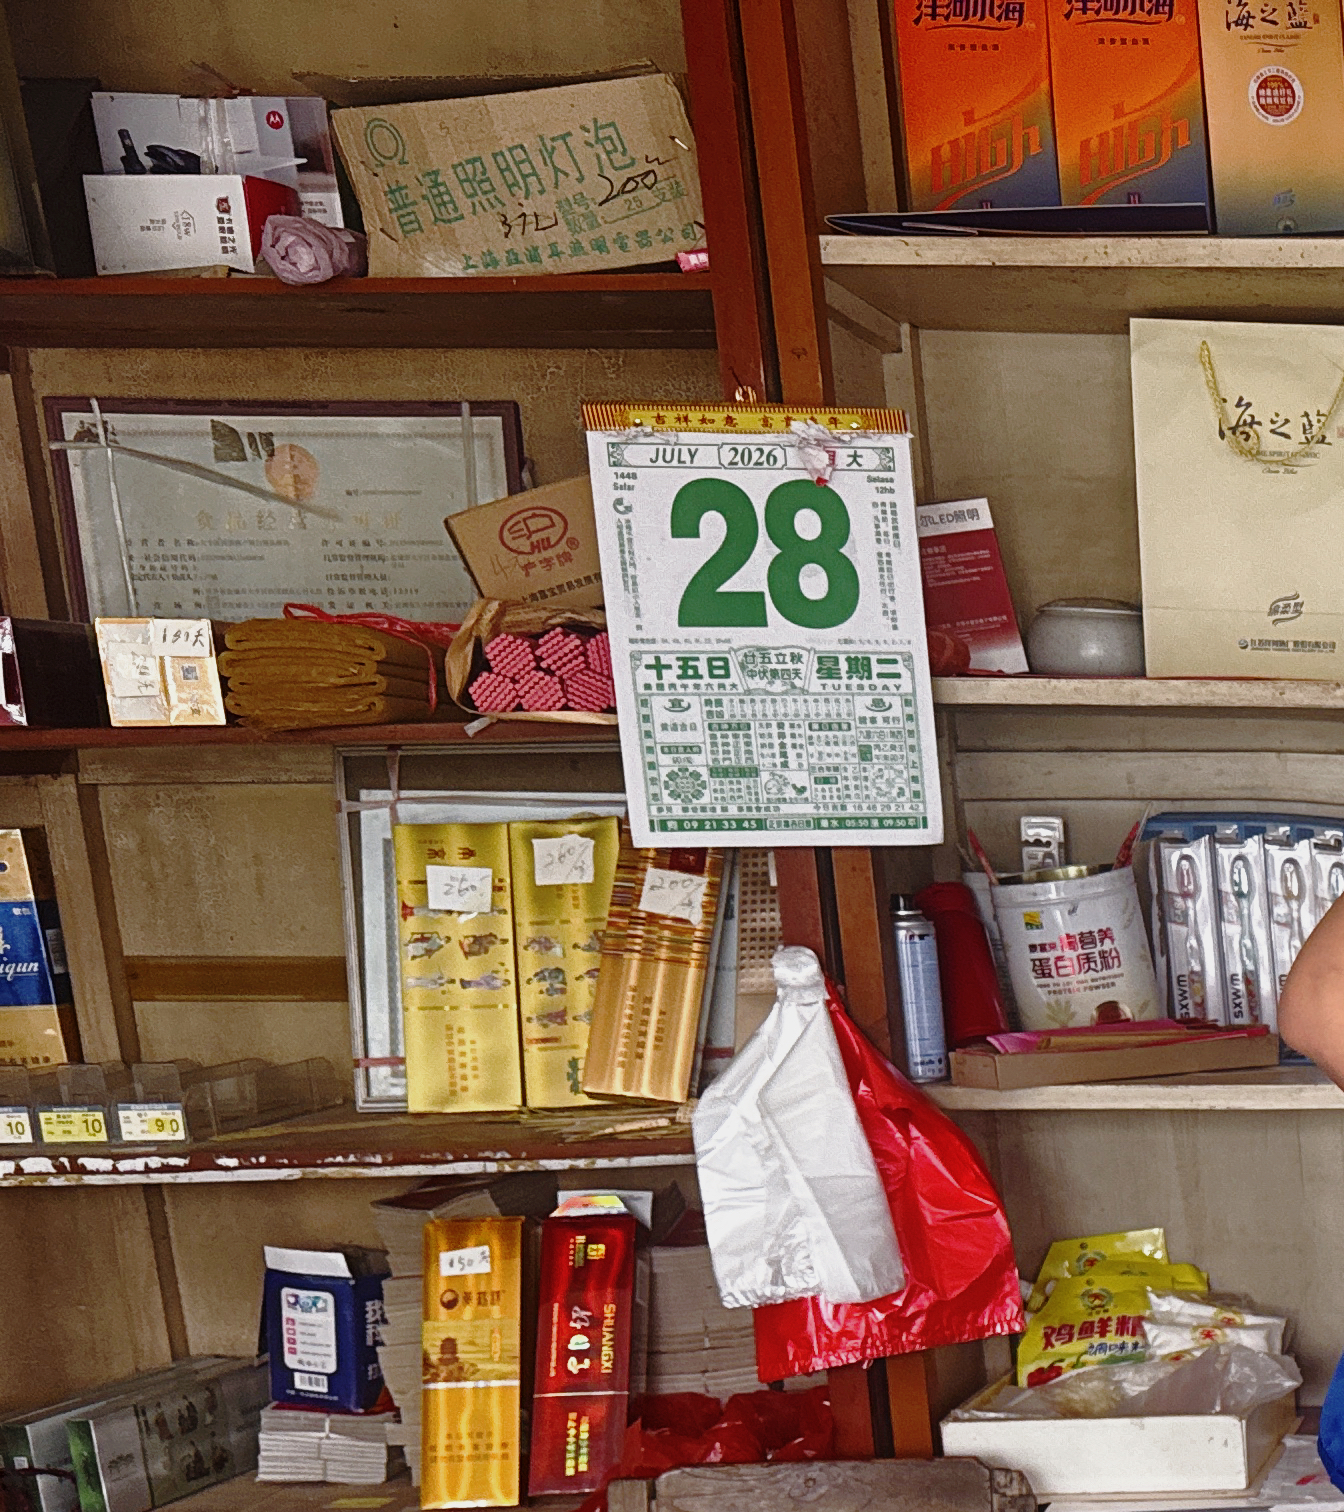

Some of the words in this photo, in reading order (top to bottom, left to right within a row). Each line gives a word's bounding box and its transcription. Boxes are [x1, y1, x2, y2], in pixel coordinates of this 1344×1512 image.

[384, 117, 637, 238] 普通照明灯泡
[651, 411, 738, 427] 吉祥如意
[650, 447, 699, 465] JULY
[728, 447, 779, 467] 2026
[846, 450, 863, 468] 大
[670, 477, 860, 630] 28
[644, 655, 732, 680] 十五日
[743, 651, 805, 666] 廿五立秋
[816, 655, 902, 681] 星期二
[820, 683, 903, 692] TUESDAY
[704, 820, 717, 829] 21
[722, 820, 737, 829] 33
[742, 820, 757, 829] 45
[1030, 947, 1122, 980] 蛋白质粉
[6, 1121, 25, 1136] 10
[82, 1118, 103, 1134] 10
[600, 1302, 618, 1375] SHUANGXI
